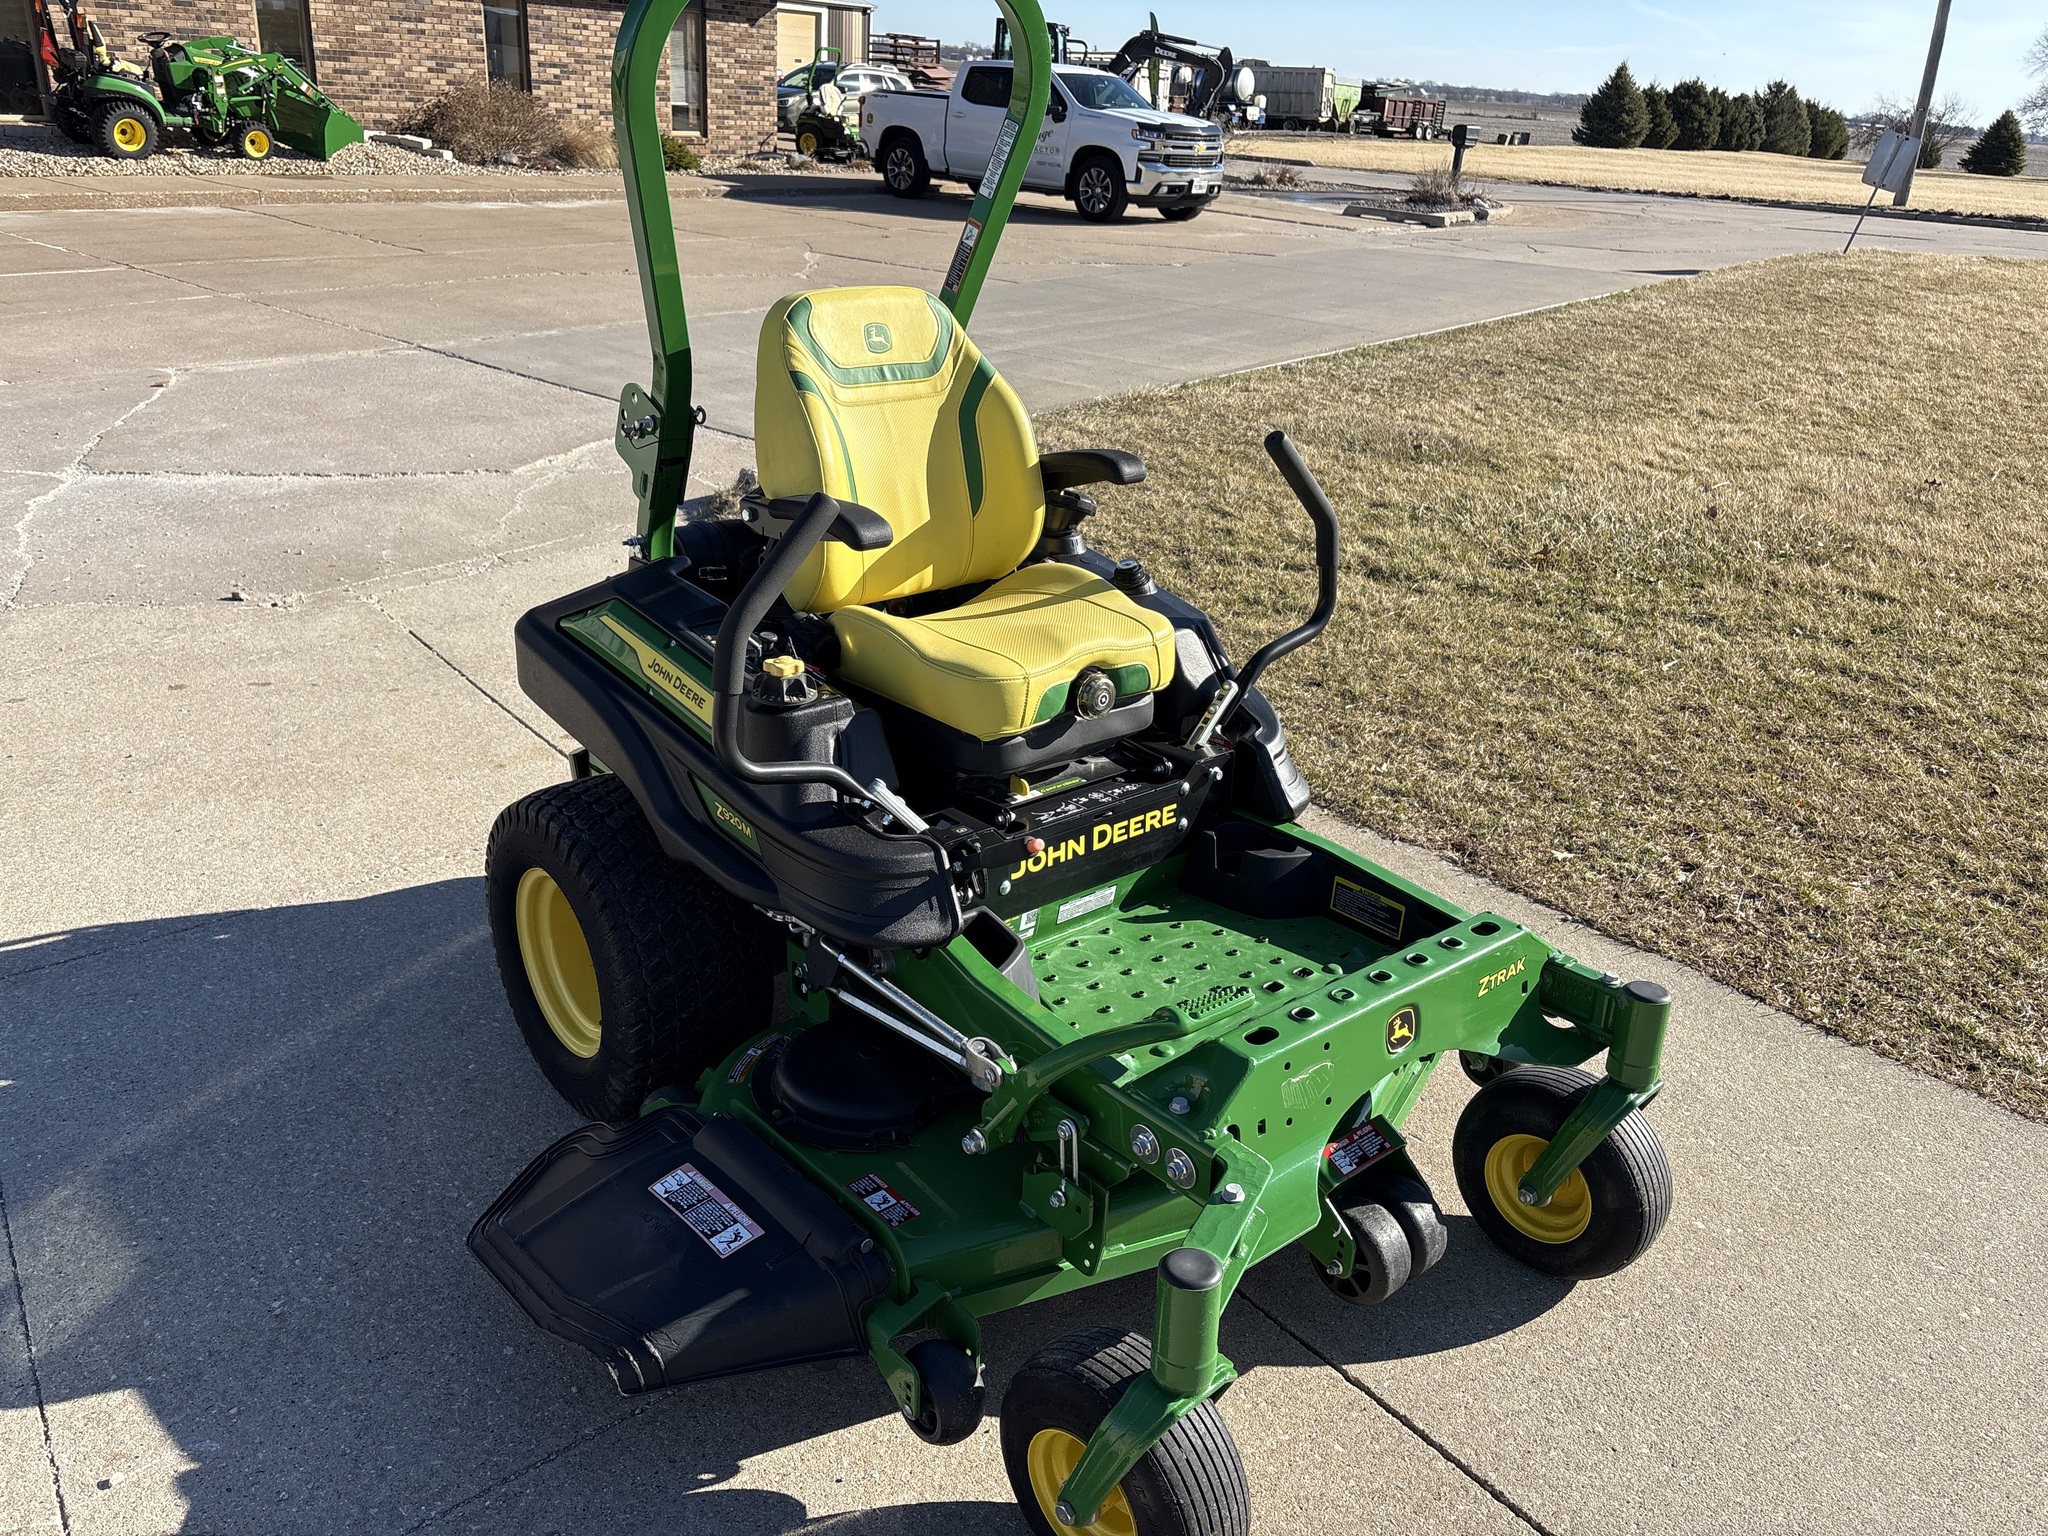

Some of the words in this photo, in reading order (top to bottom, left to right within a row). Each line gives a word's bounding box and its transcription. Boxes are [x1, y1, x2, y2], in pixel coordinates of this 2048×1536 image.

[1154, 46, 1178, 59] DEERE
[1035, 146, 1061, 155] ACTOR
[647, 658, 674, 684] JOHN
[672, 675, 706, 709] DEERE
[714, 801, 752, 838] Z920M
[1010, 834, 1086, 880] JOHN
[1092, 803, 1177, 851] DEERE
[1477, 954, 1527, 998] ZTRAK
[693, 1173, 713, 1192] DANGER
[729, 1206, 752, 1226] PELIGRO
[904, 1202, 921, 1216] PELIGRO
